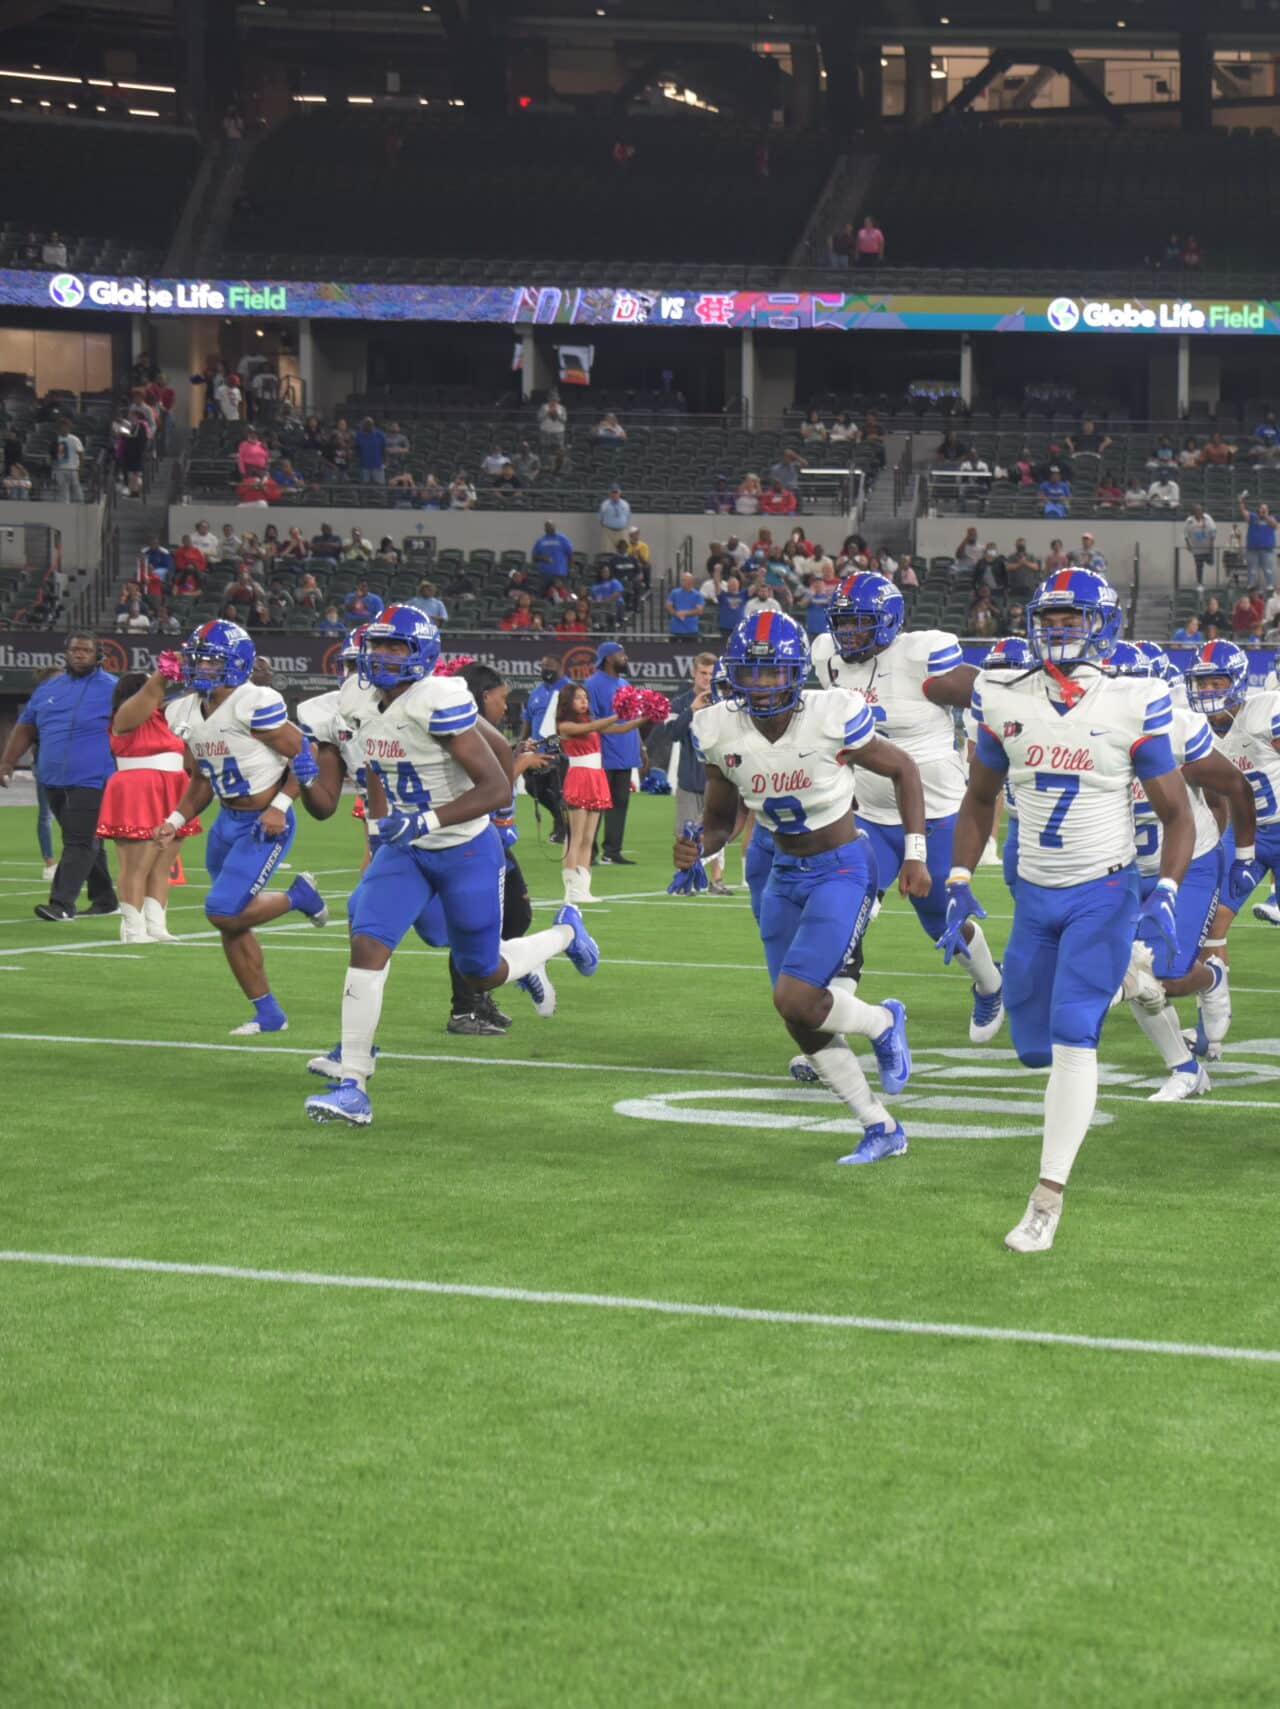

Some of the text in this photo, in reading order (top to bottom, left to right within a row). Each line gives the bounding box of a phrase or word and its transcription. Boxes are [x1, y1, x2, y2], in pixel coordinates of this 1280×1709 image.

[88, 280, 286, 310] Globe Life Field
[661, 296, 684, 319] VS
[1083, 303, 1265, 329] Globe Life Field
[621, 659, 676, 678] van
[366, 739, 407, 758] D'Ville
[1024, 744, 1095, 771] D'Ville
[751, 768, 812, 794] D'Ville
[1035, 772, 1080, 848] 7
[250, 843, 283, 897] PANTHERS
